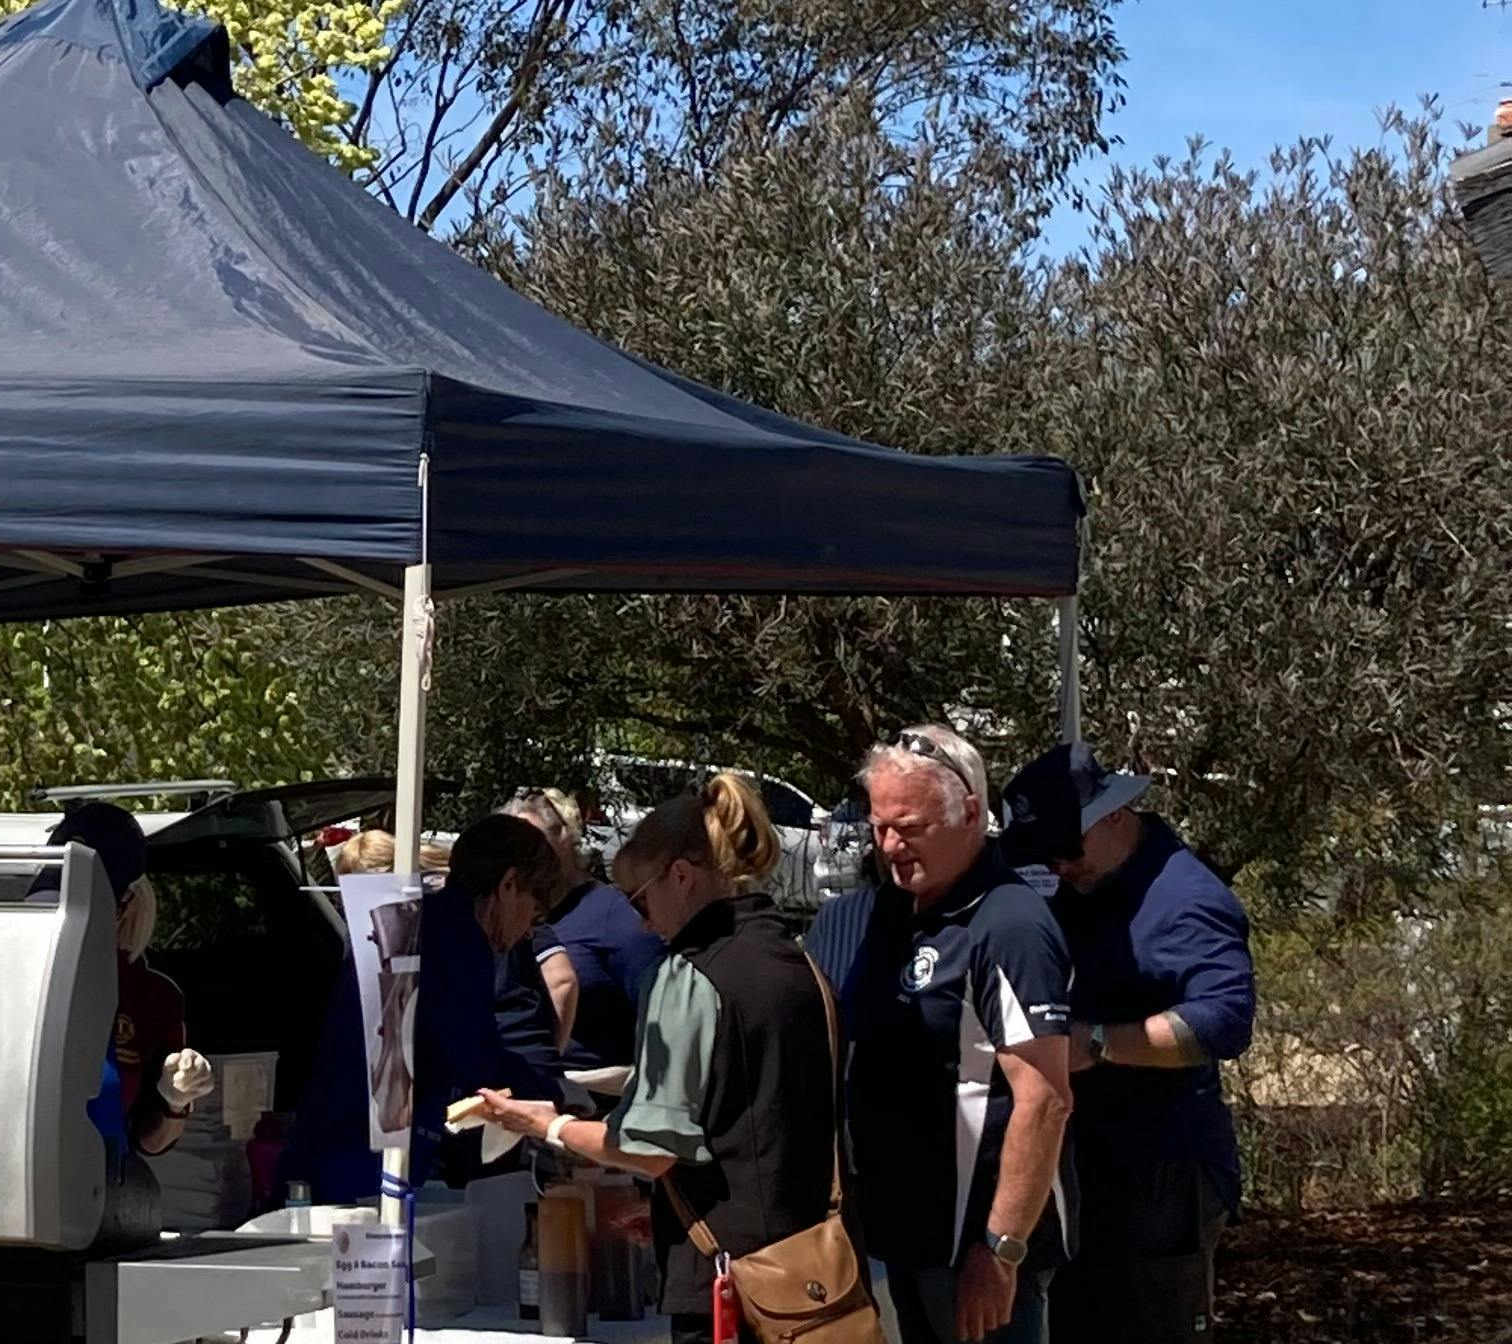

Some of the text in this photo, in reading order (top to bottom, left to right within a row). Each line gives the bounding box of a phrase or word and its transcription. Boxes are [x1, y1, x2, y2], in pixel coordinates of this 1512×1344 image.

[336, 1260, 352, 1271] Egg
[361, 1260, 389, 1268] Bacon
[336, 1282, 387, 1292] Hamburger
[337, 1310, 374, 1320] Sausage
[338, 1330, 388, 1339] Cold Drinks
